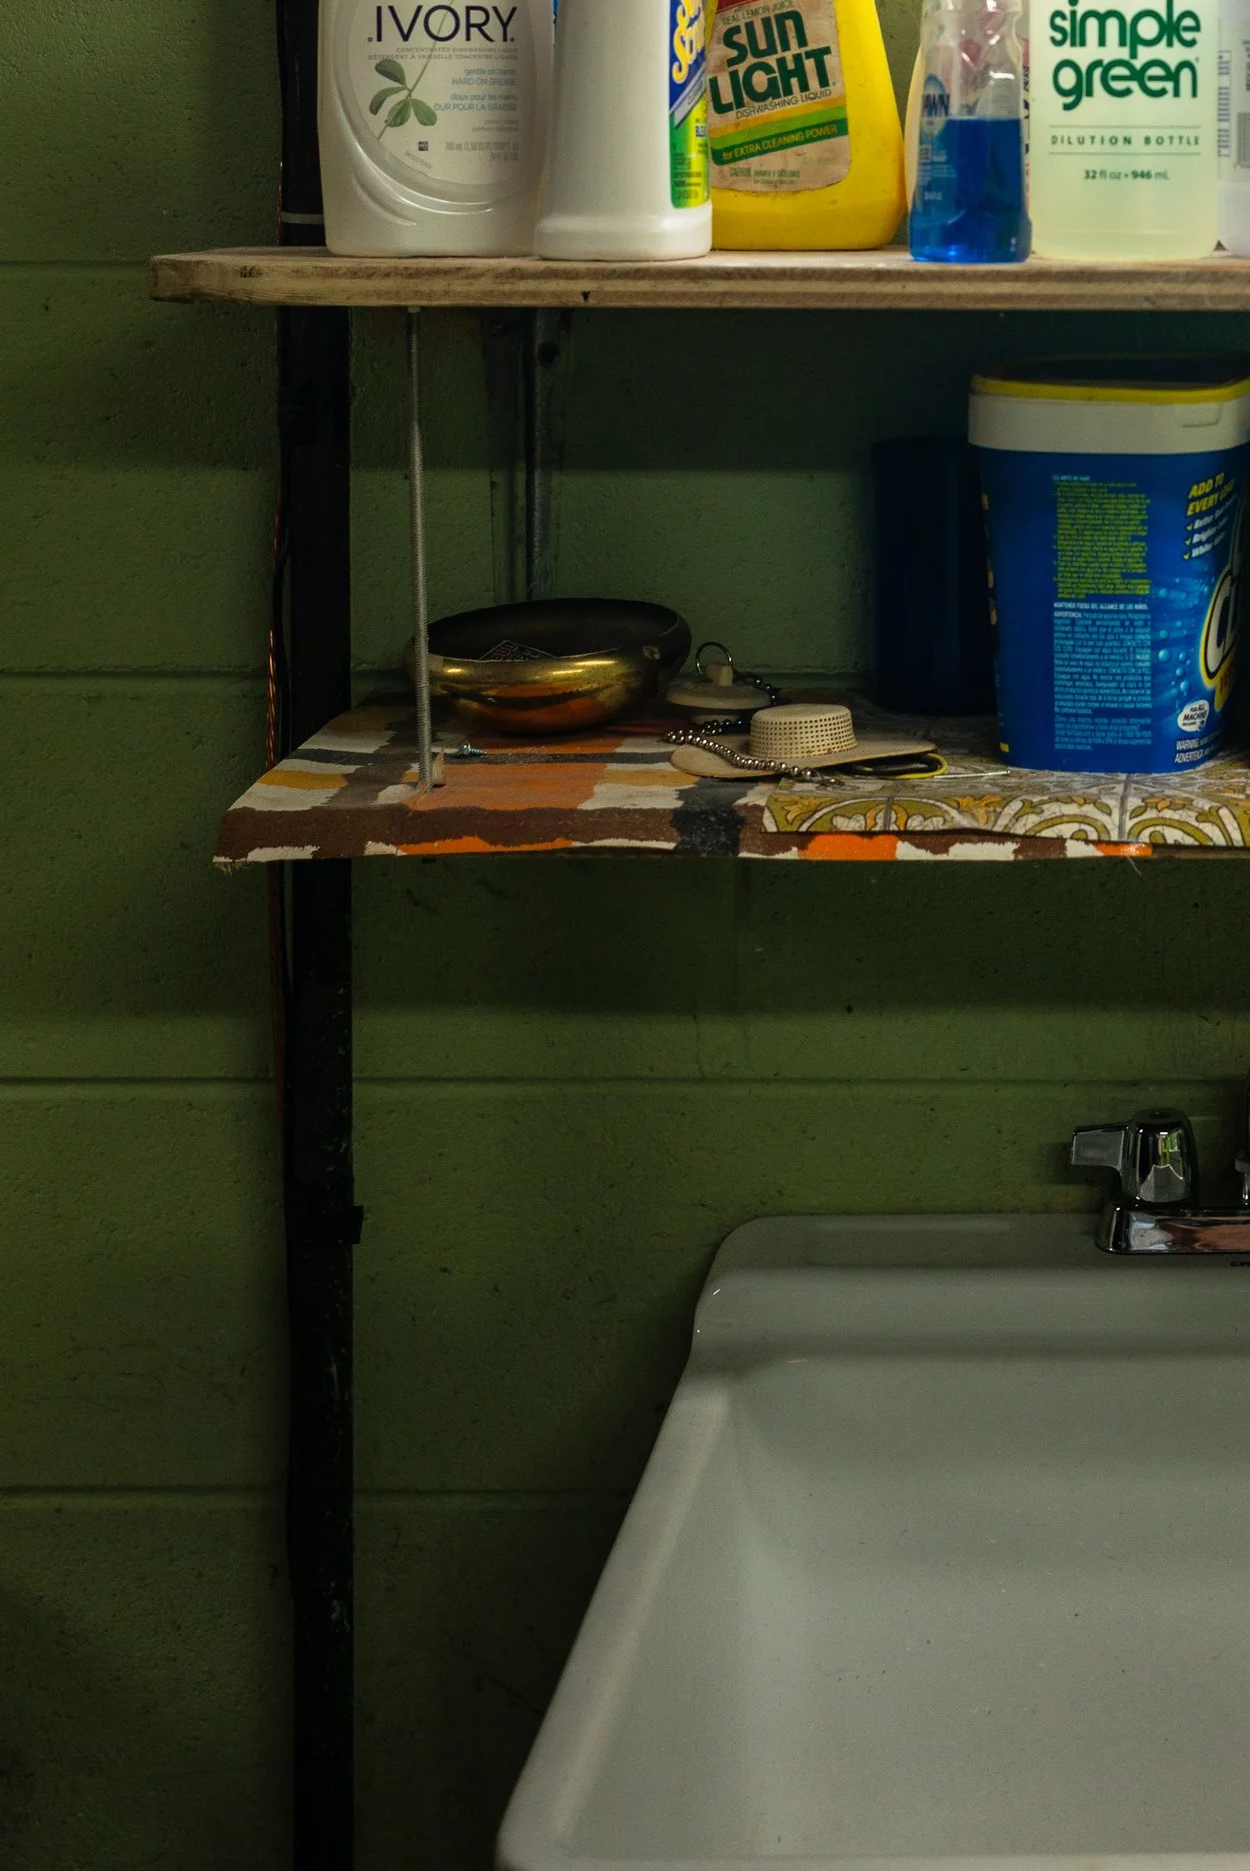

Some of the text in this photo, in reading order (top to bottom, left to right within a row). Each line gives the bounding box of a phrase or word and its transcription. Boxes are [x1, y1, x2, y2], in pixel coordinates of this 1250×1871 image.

[375, 4, 518, 43] IVORY
[742, 4, 771, 20] LEMON
[709, 46, 834, 115] LIGHT
[1052, 59, 1198, 112] green
[735, 88, 832, 120] DISHWASHING LIQUID
[722, 124, 838, 160] for EXTRA CLEANING POWER
[1051, 135, 1200, 145] DILUTION BOTTLE
[1084, 170, 1096, 180] 32
[1188, 479, 1214, 499] ADD
